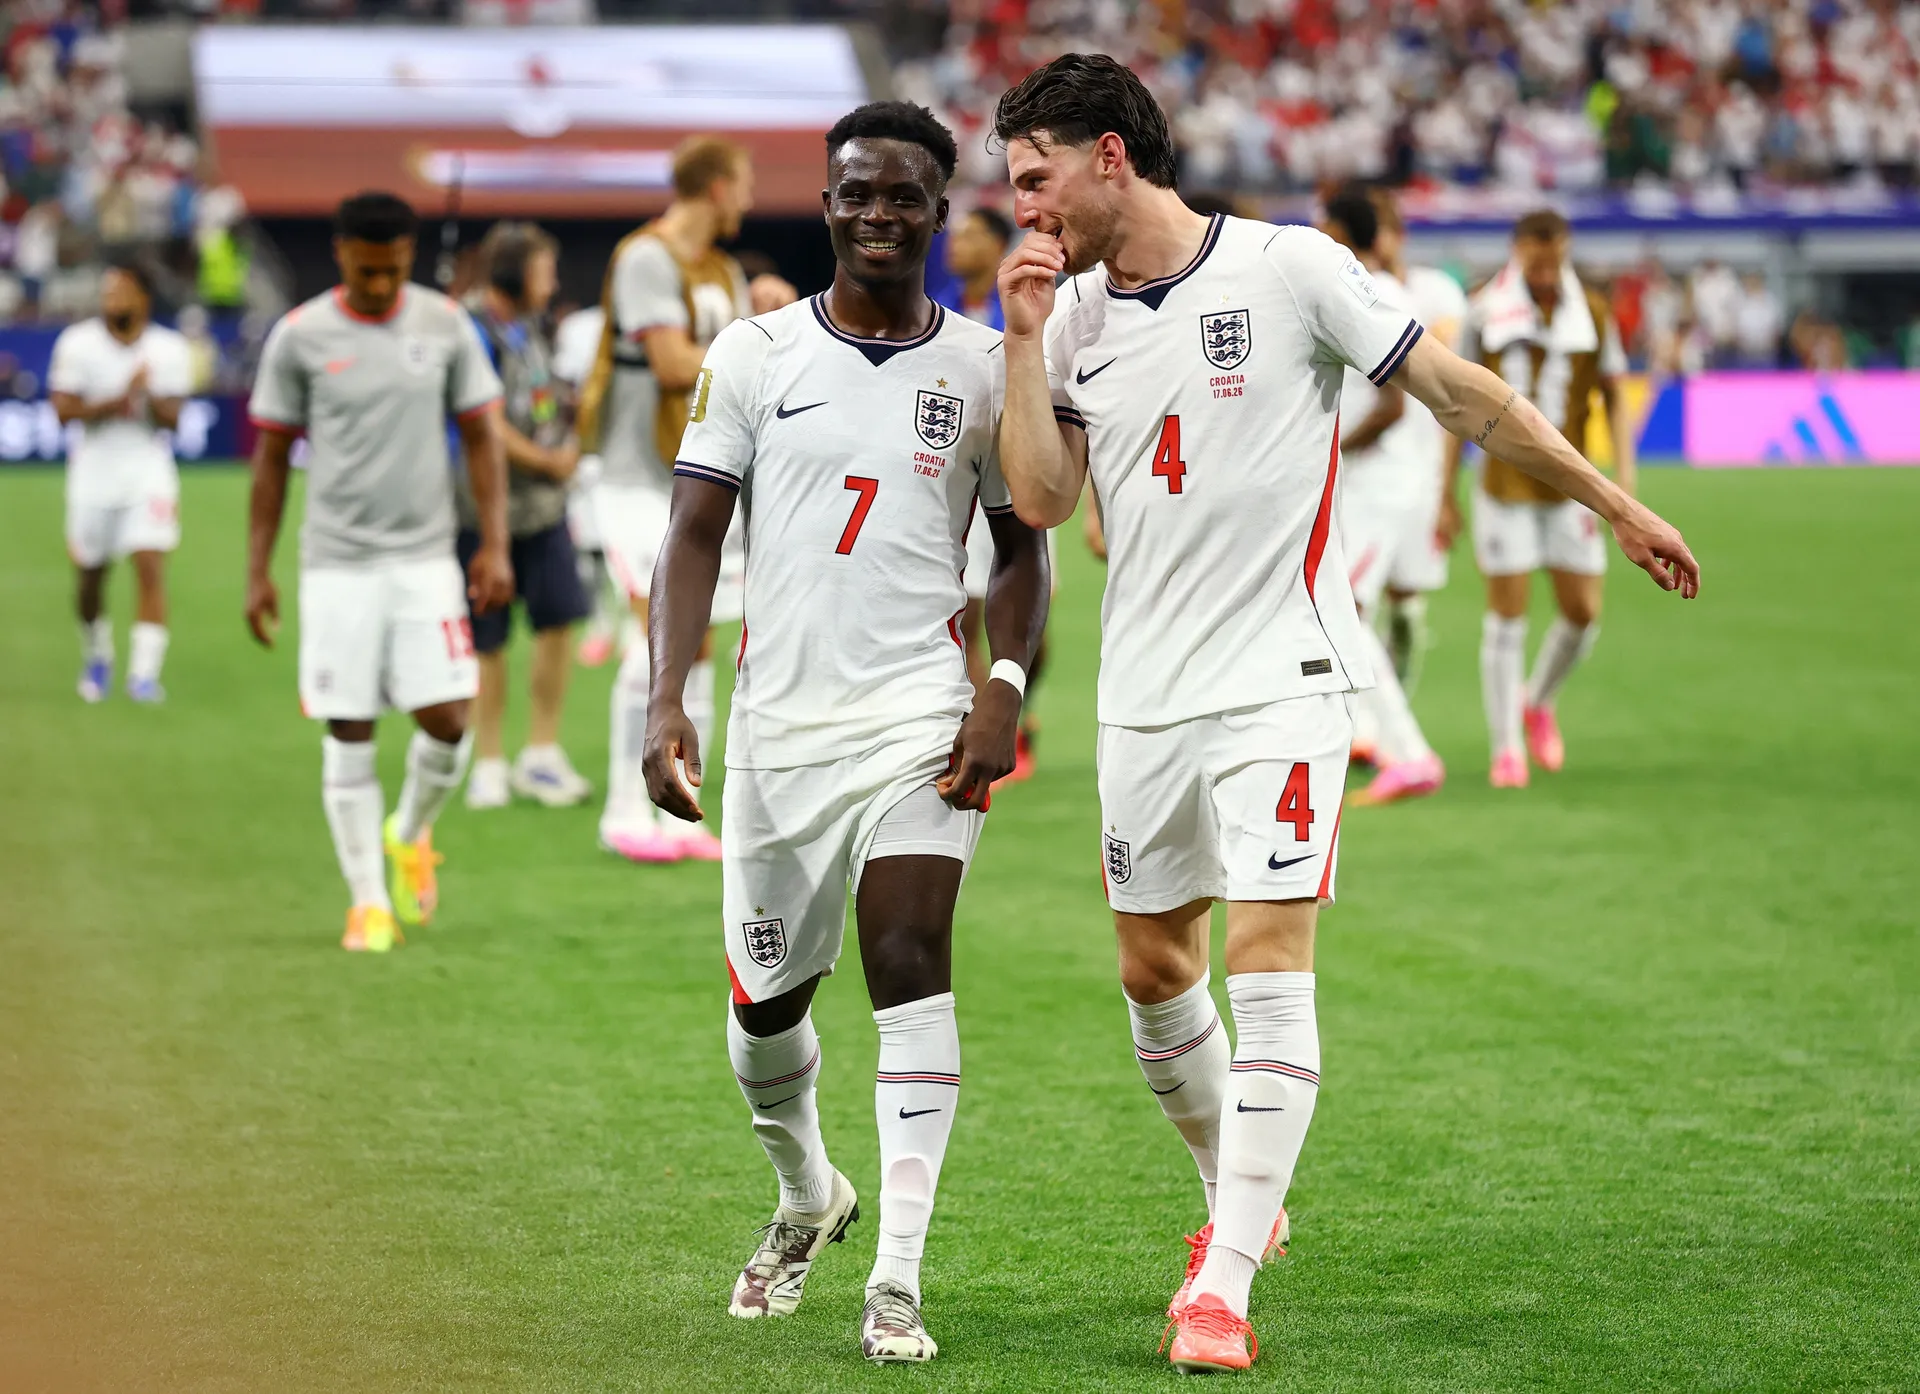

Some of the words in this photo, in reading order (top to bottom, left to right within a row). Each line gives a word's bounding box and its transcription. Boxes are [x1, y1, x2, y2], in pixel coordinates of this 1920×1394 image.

[1209, 374, 1245, 387] CROATIA
[1213, 387, 1243, 399] 17.06.26
[913, 451, 946, 468] CROATIA
[1152, 414, 1187, 495] 4
[834, 475, 879, 555] 7
[1276, 762, 1315, 842] 4
